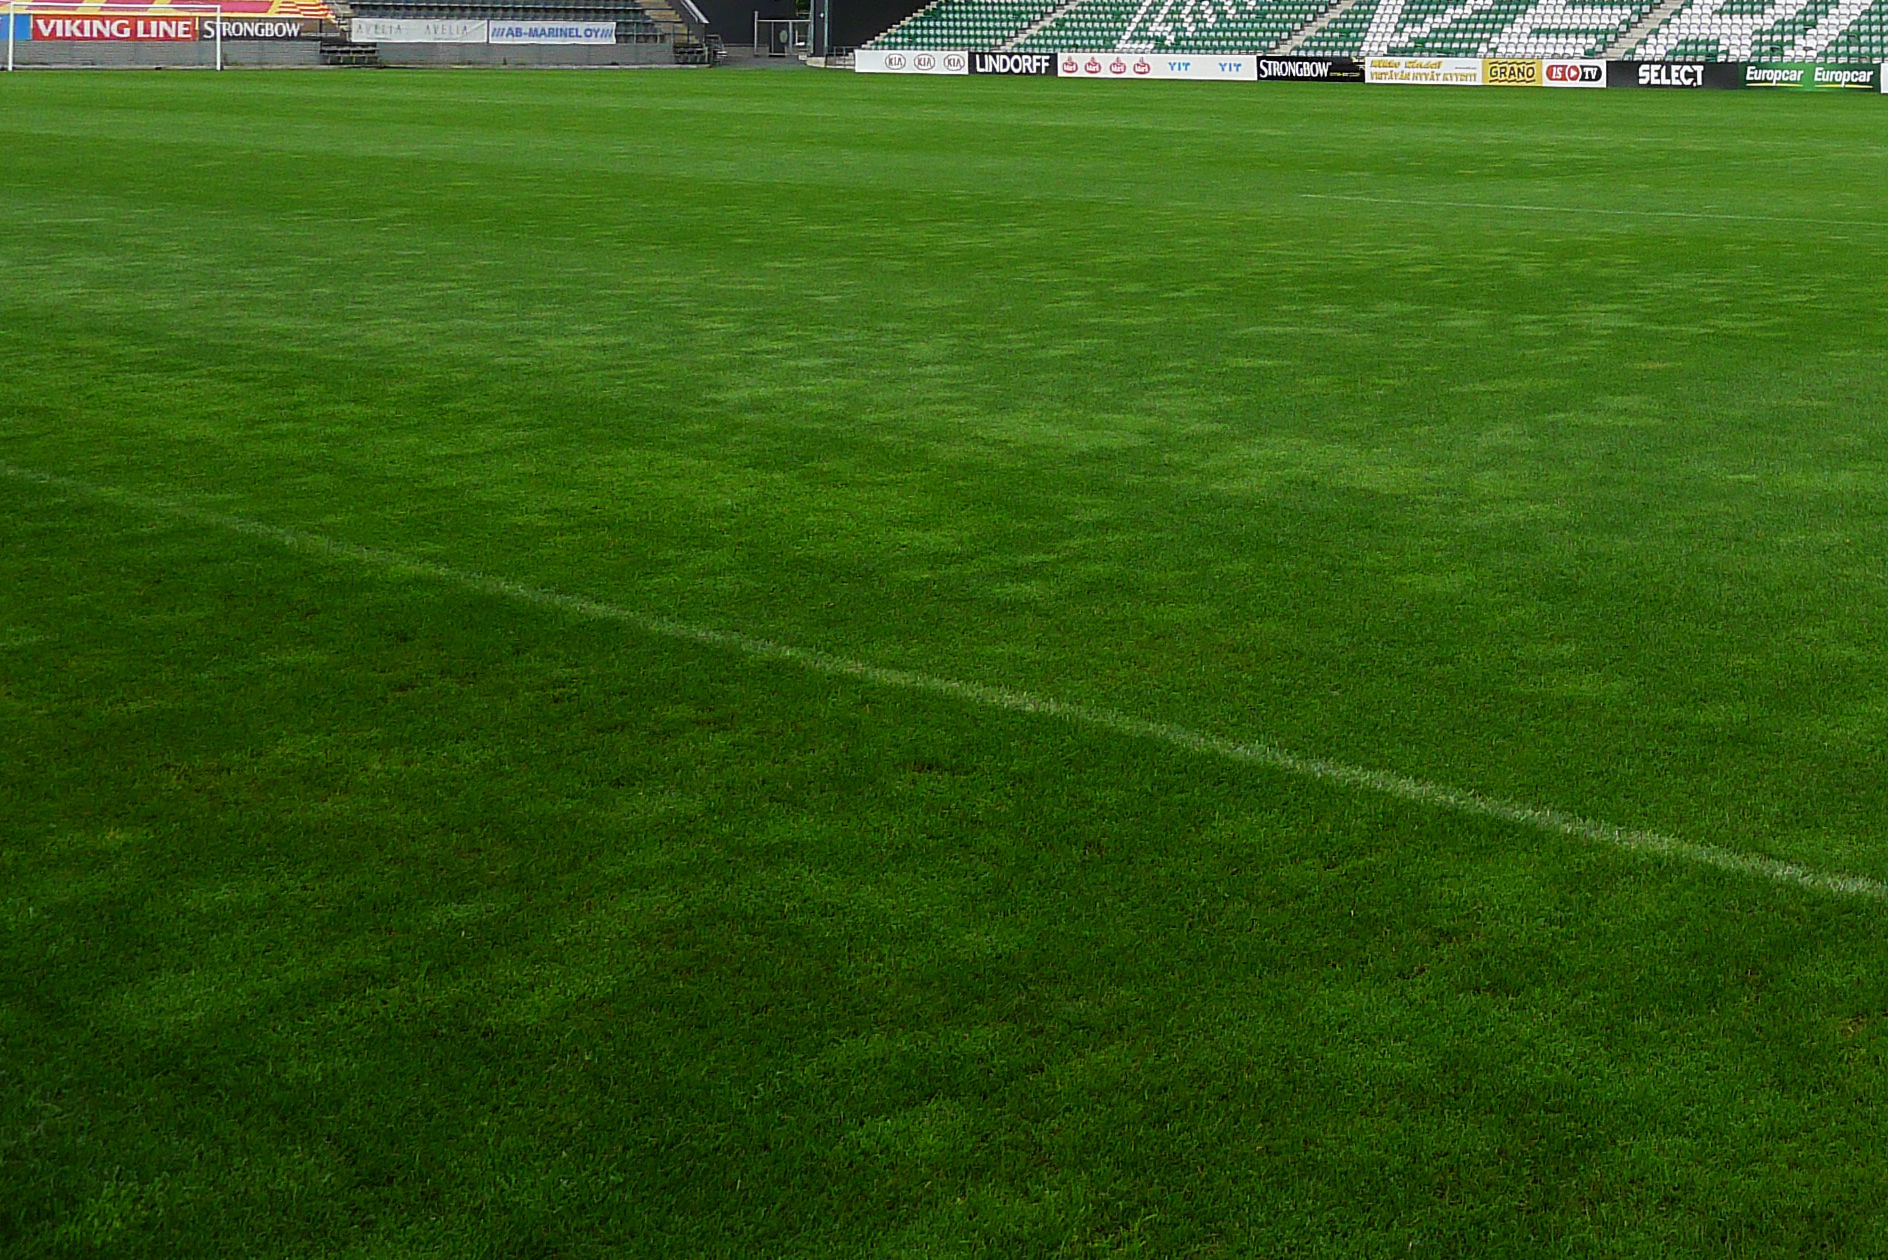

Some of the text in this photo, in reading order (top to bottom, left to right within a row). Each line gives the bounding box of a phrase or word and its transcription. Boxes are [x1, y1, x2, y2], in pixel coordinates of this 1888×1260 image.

[36, 19, 191, 38] VIKING LINE
[203, 20, 300, 38] STRONGBOW
[506, 27, 582, 38] AB-MARINEL
[889, 57, 903, 68] KIA
[918, 57, 932, 68] KIA
[948, 58, 961, 69] KIA
[976, 55, 1049, 73] LINDORFF
[1168, 62, 1191, 71] YIT
[1219, 63, 1242, 73] YIT
[1259, 60, 1330, 77] STRONGBOW
[1490, 65, 1535, 79] GRANO
[1583, 67, 1598, 79] TV
[1746, 66, 1803, 85] Europcar
[1814, 66, 1873, 86] Europcar
